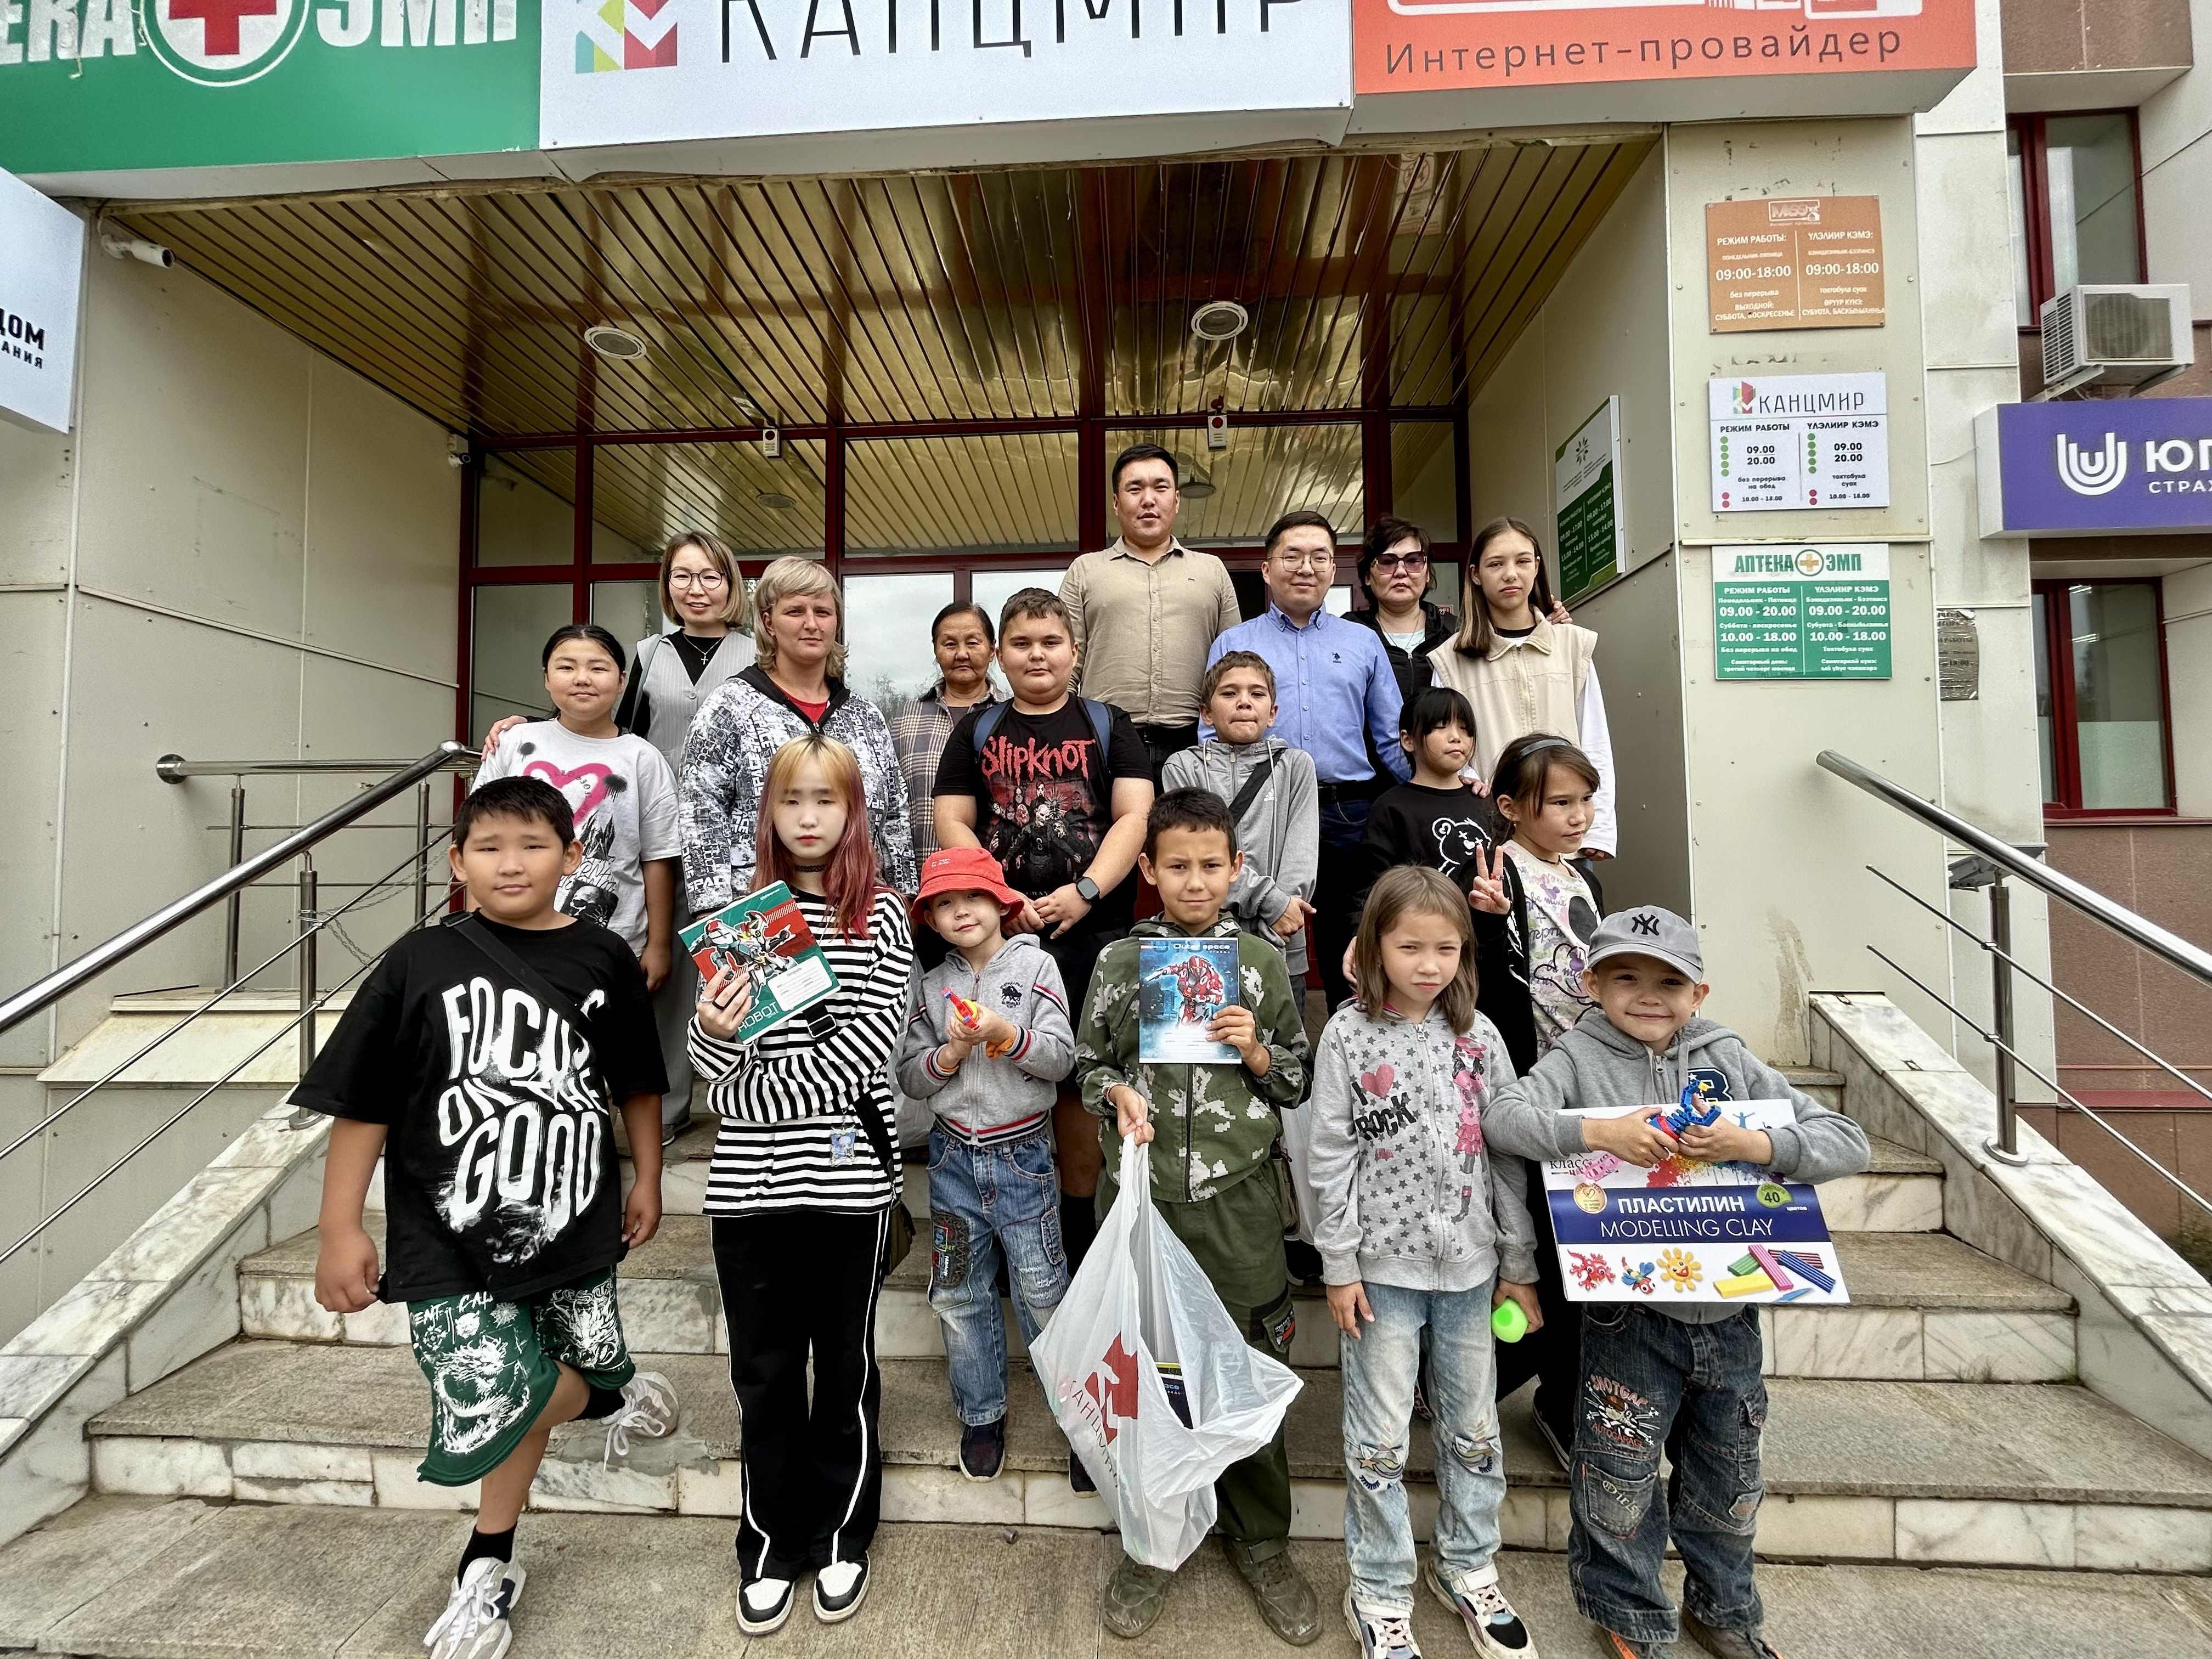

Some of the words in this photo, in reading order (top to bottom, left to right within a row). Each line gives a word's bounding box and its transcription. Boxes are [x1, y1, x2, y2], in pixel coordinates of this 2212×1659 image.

[1384, 25, 1902, 76] Интернет-провайдер
[1717, 235, 1748, 246] РЕЖИМ
[1750, 234, 1787, 243] РАБОТЫ:
[1716, 266, 1791, 281] 09:00-18:00
[1805, 263, 1879, 275] 09:00-18:00
[1744, 289, 1779, 298] перерыва
[1735, 302, 1774, 311] ВЫХОДНОЙ:
[1716, 312, 1746, 321] СУББОТА,
[1759, 392, 1864, 414] КАНЦМИР
[1756, 424, 1790, 432] РАБОТЫ
[1747, 445, 1775, 454] 09.00
[1834, 442, 1863, 452] 09.00
[1747, 456, 1775, 465] 20.00
[1835, 454, 1863, 462] 20.00
[2148, 481, 2212, 494] СТРА
[1735, 555, 1794, 572] АПТЕКА
[1826, 554, 1861, 571] ЭМП
[1719, 606, 1753, 617] 09.00
[1762, 606, 1796, 616] 20.00
[1809, 606, 1842, 616] 09.00
[1852, 605, 1886, 616] 20.00
[1720, 633, 1753, 642] 10.00
[1763, 632, 1797, 642] 18.00
[1809, 632, 1843, 641] 10.00
[1853, 631, 1886, 641] 18.00
[1632, 913, 1659, 936] NY
[1351, 1081, 1368, 1107] I
[1355, 1092, 1416, 1141] ROCK
[449, 1101, 601, 1242] GOOD
[1764, 1192, 1780, 1203] 40
[1617, 1195, 1745, 1214] ПЛАСТИЛИН
[1600, 1219, 1719, 1238] MODELLING
[1724, 1218, 1773, 1237] CLAY
[1070, 1380, 1118, 1488] АНЦМ
